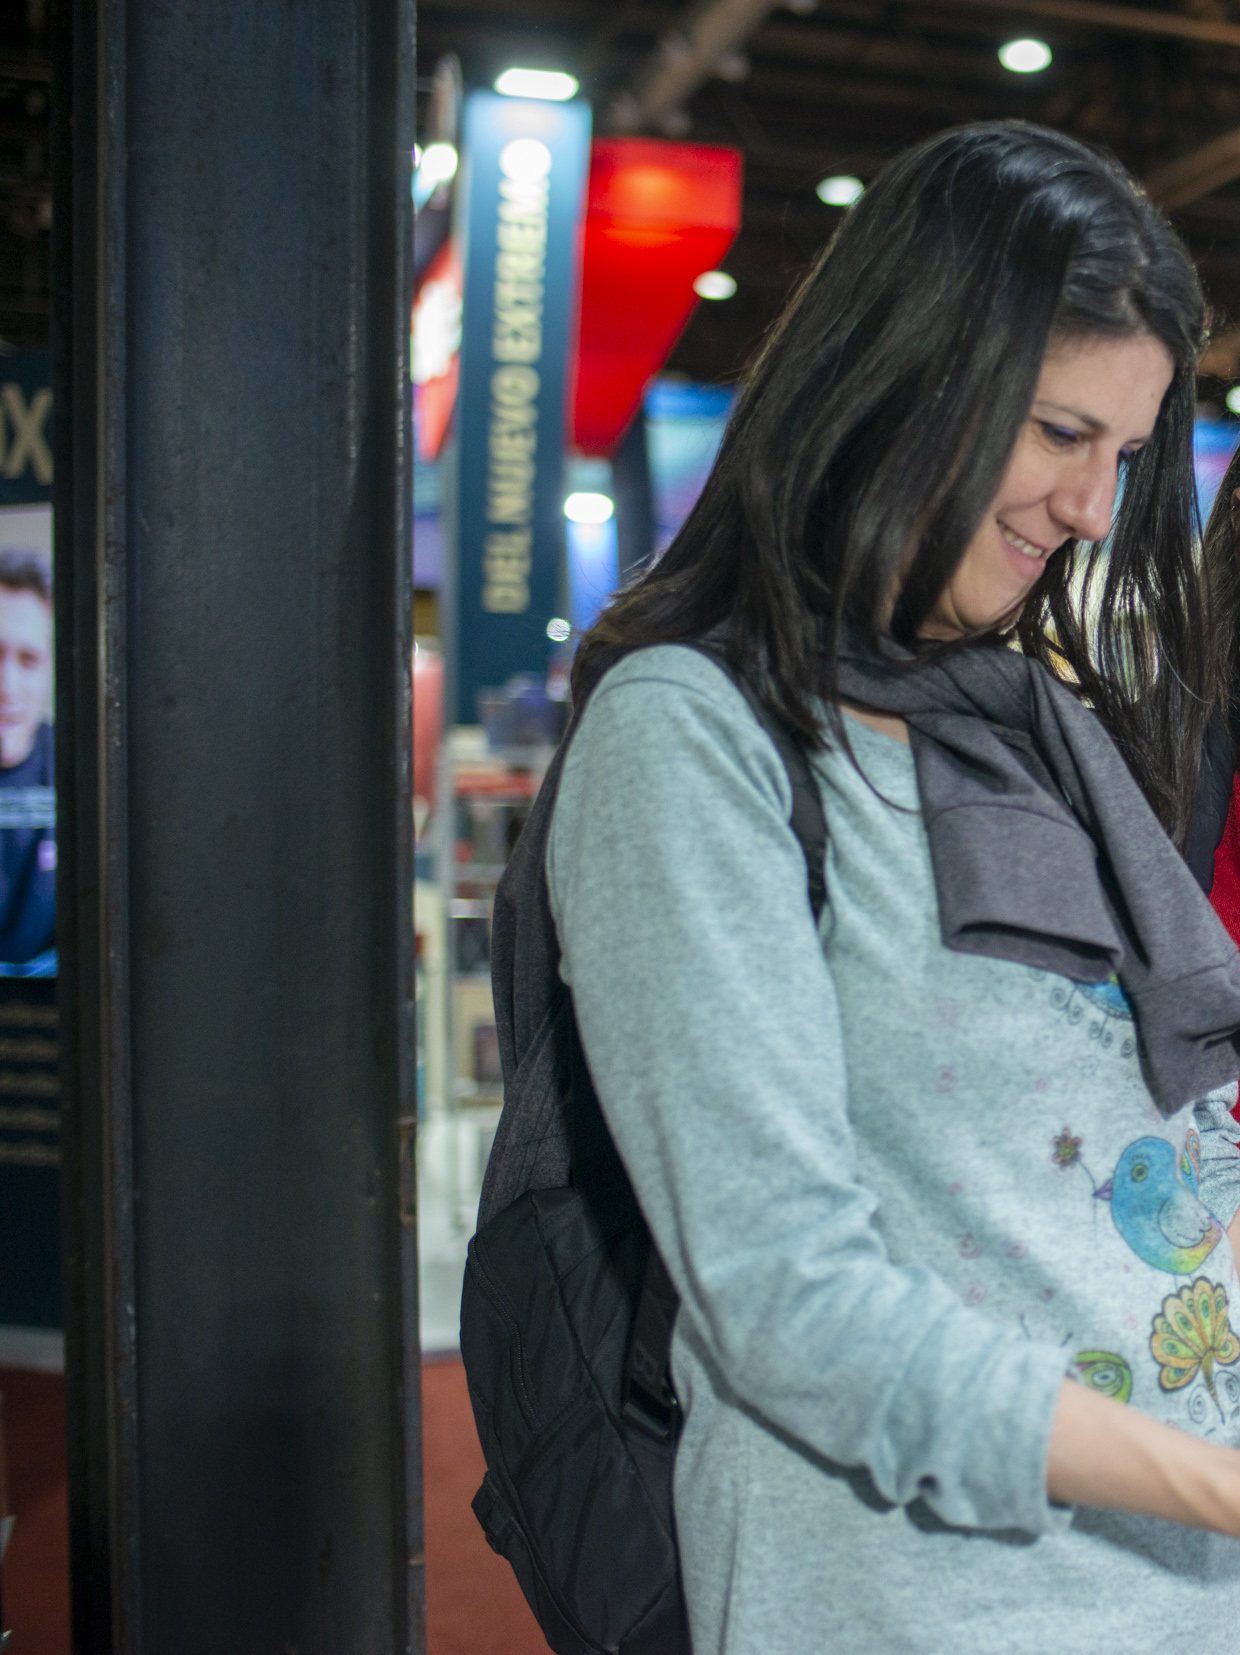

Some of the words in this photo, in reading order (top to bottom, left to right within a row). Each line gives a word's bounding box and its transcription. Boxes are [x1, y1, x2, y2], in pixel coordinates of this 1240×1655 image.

[0, 381, 53, 486] X
[486, 365, 541, 524] NUEVO
[482, 526, 531, 612] DEL
